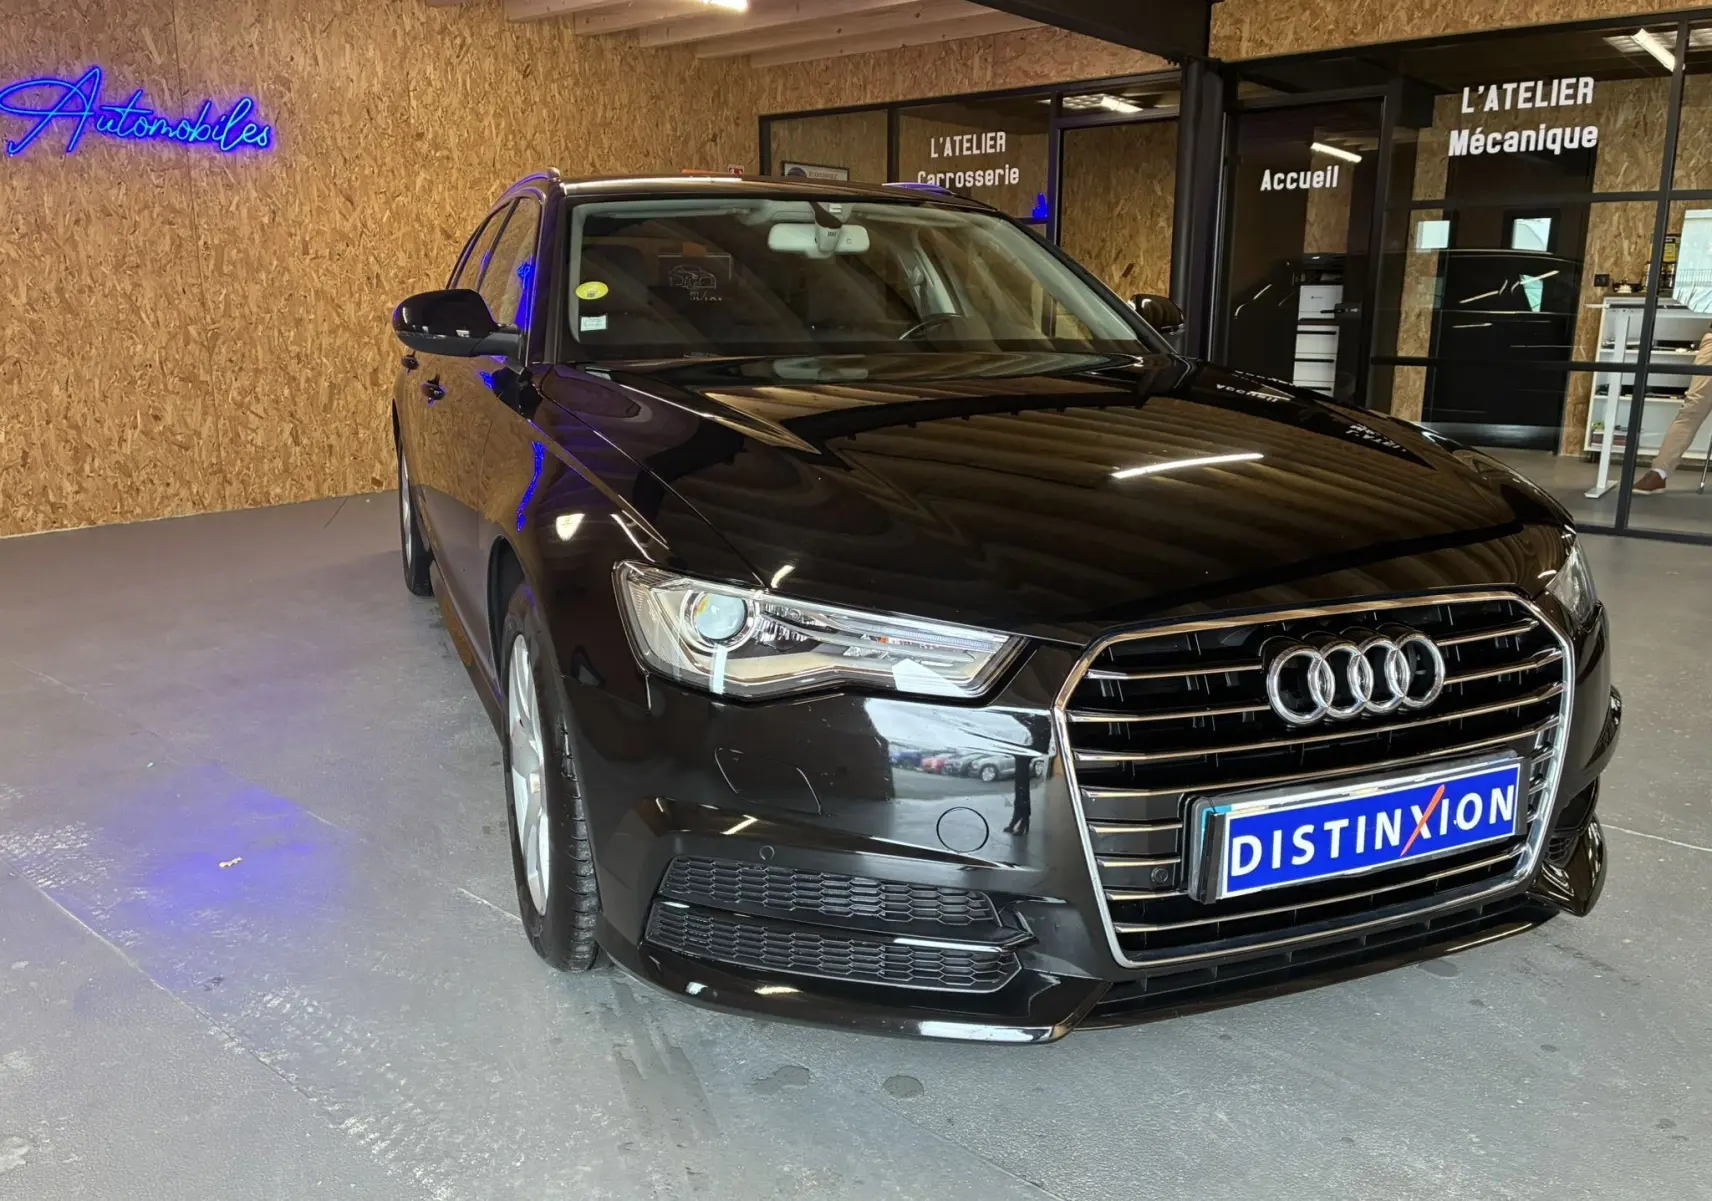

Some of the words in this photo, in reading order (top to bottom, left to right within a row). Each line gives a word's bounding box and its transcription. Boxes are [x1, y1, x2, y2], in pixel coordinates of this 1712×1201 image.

[0, 65, 273, 154] Automobiles
[1461, 76, 1595, 115] L'ATELIER
[930, 131, 1007, 158] L'ATELIER
[1448, 123, 1599, 158] Mécanique
[917, 164, 1020, 189] Carrosserie
[1260, 165, 1339, 192] Accueil
[1231, 783, 1515, 878] DISTINXION
